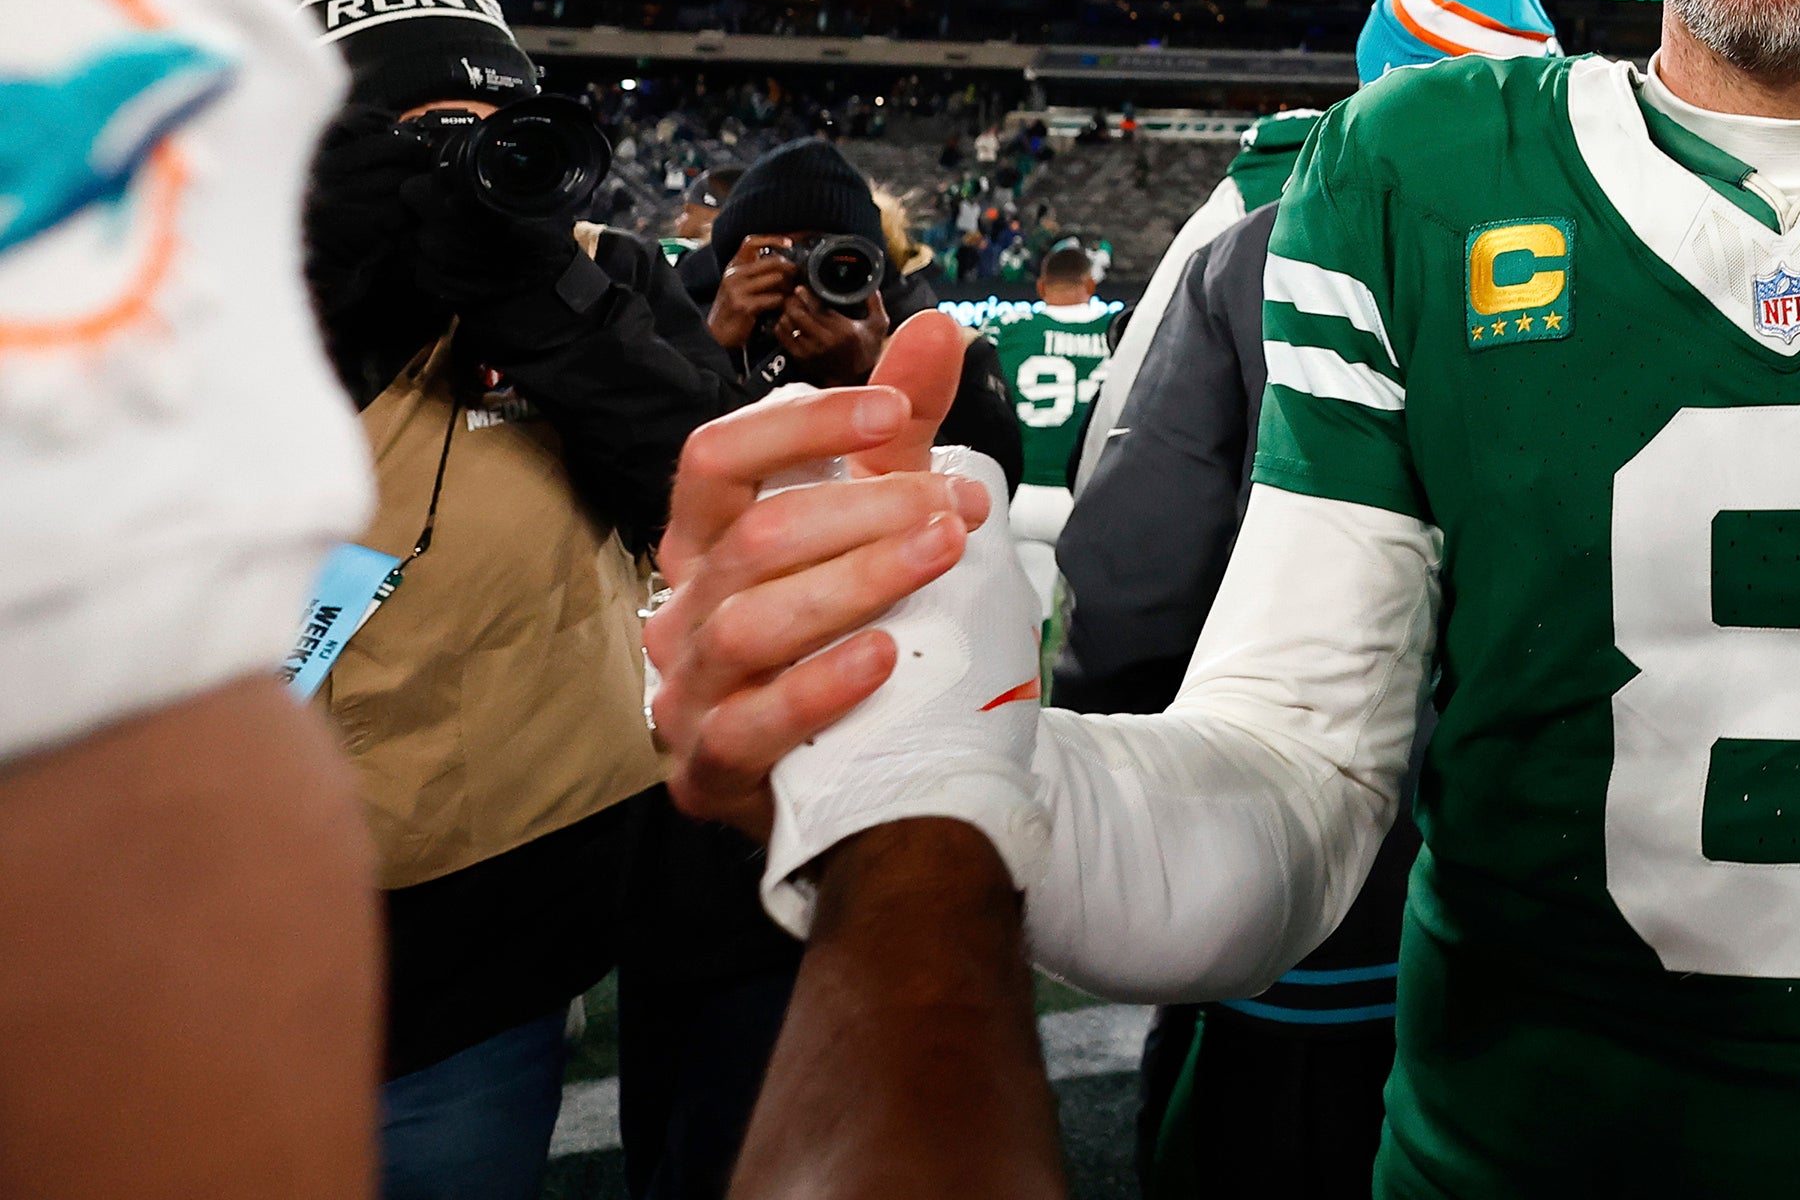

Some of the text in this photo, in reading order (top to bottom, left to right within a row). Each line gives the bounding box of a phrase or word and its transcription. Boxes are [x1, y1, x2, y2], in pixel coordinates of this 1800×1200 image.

[1469, 223, 1567, 316] C
[466, 399, 530, 432] MEDI
[286, 605, 343, 664] WEEK
